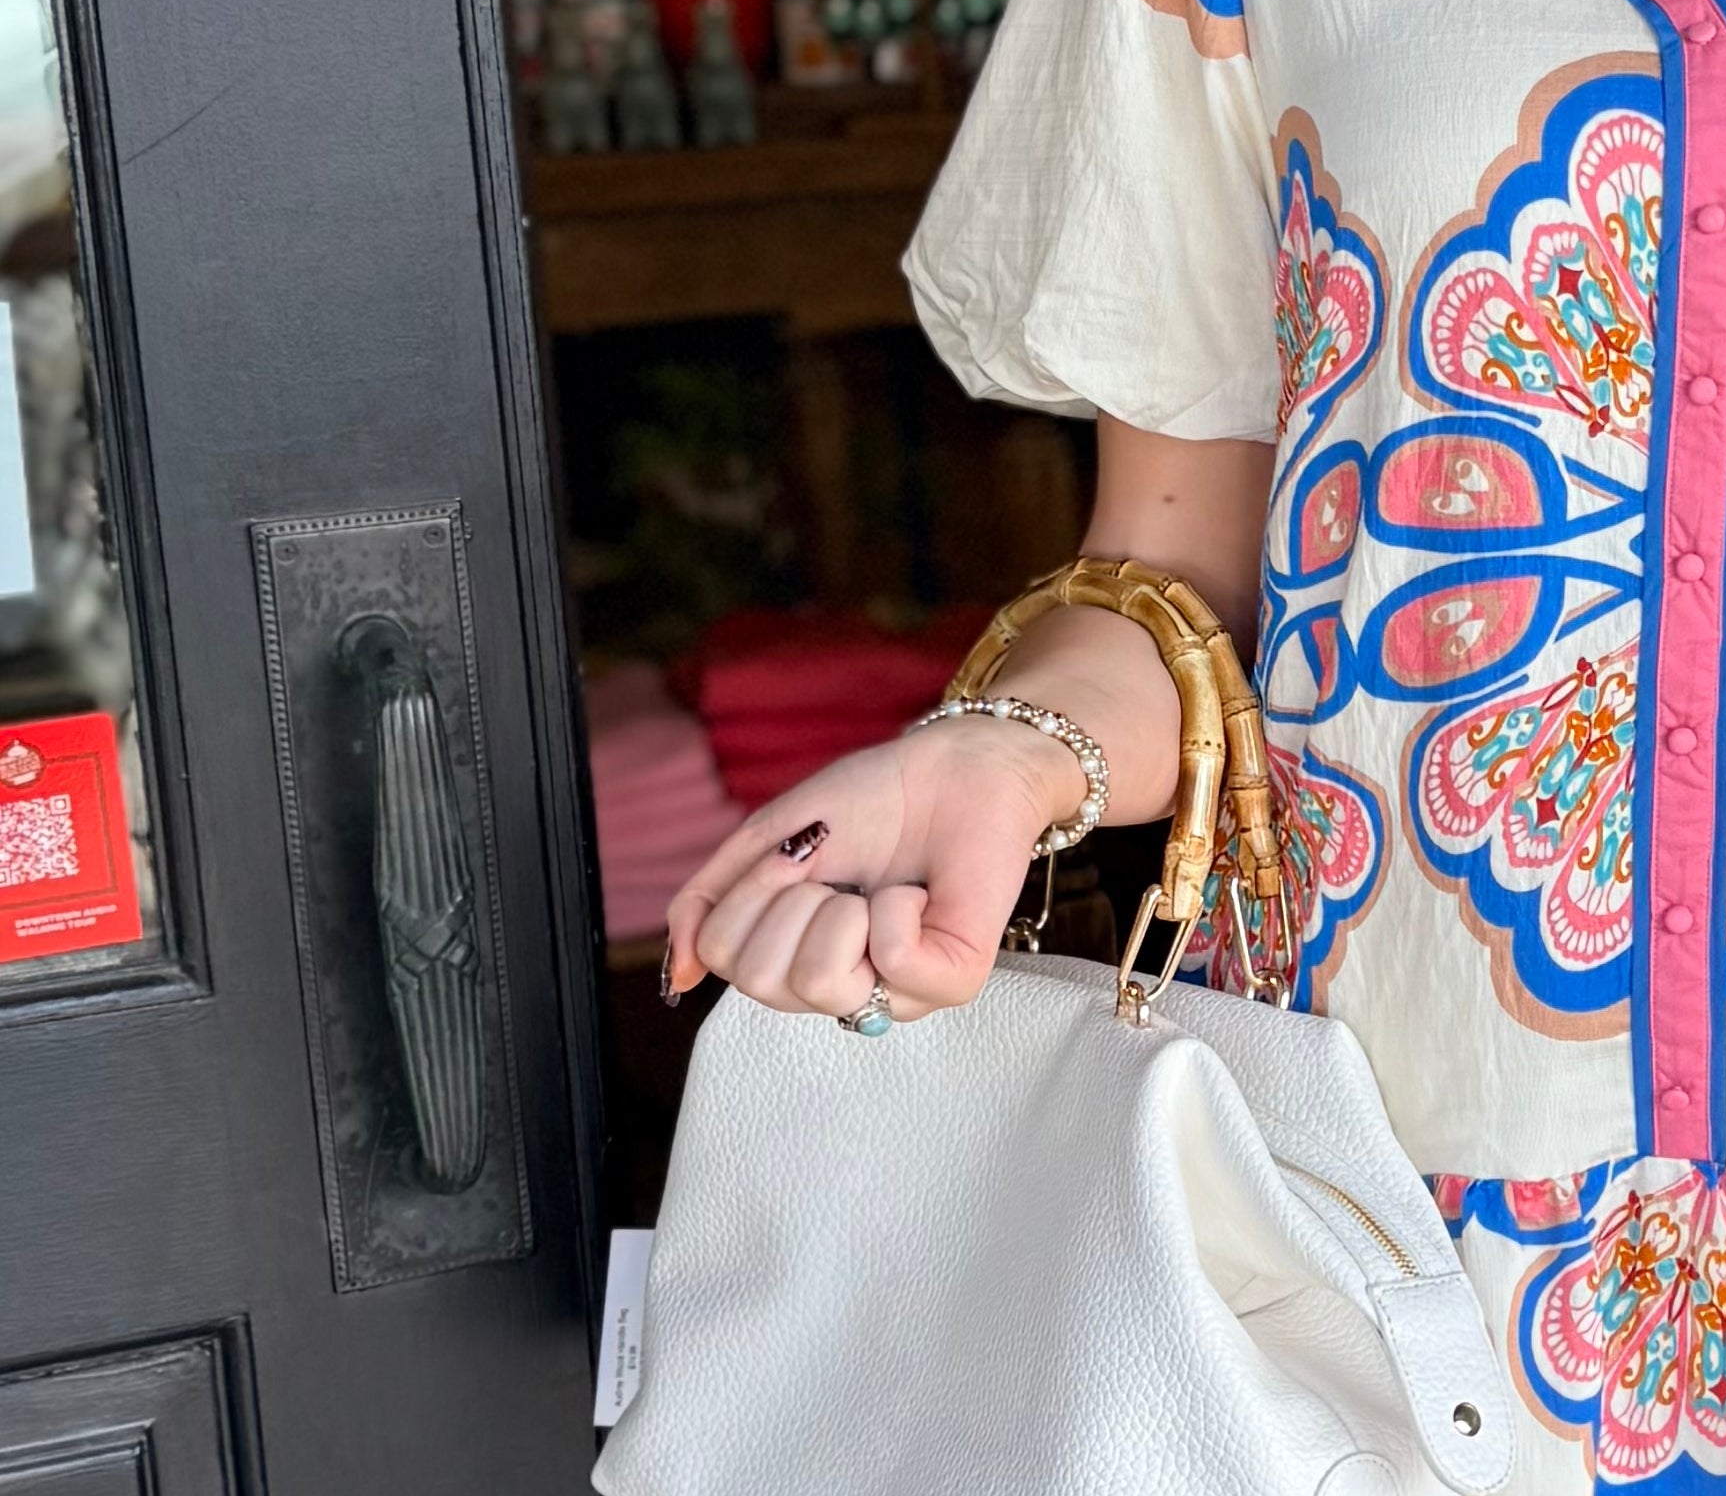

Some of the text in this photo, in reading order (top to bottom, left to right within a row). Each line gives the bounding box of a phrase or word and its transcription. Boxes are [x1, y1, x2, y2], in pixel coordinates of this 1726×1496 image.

[15, 904, 118, 929] DOWNTOWN AUDIO
[16, 917, 96, 937] WALKING TOUR
